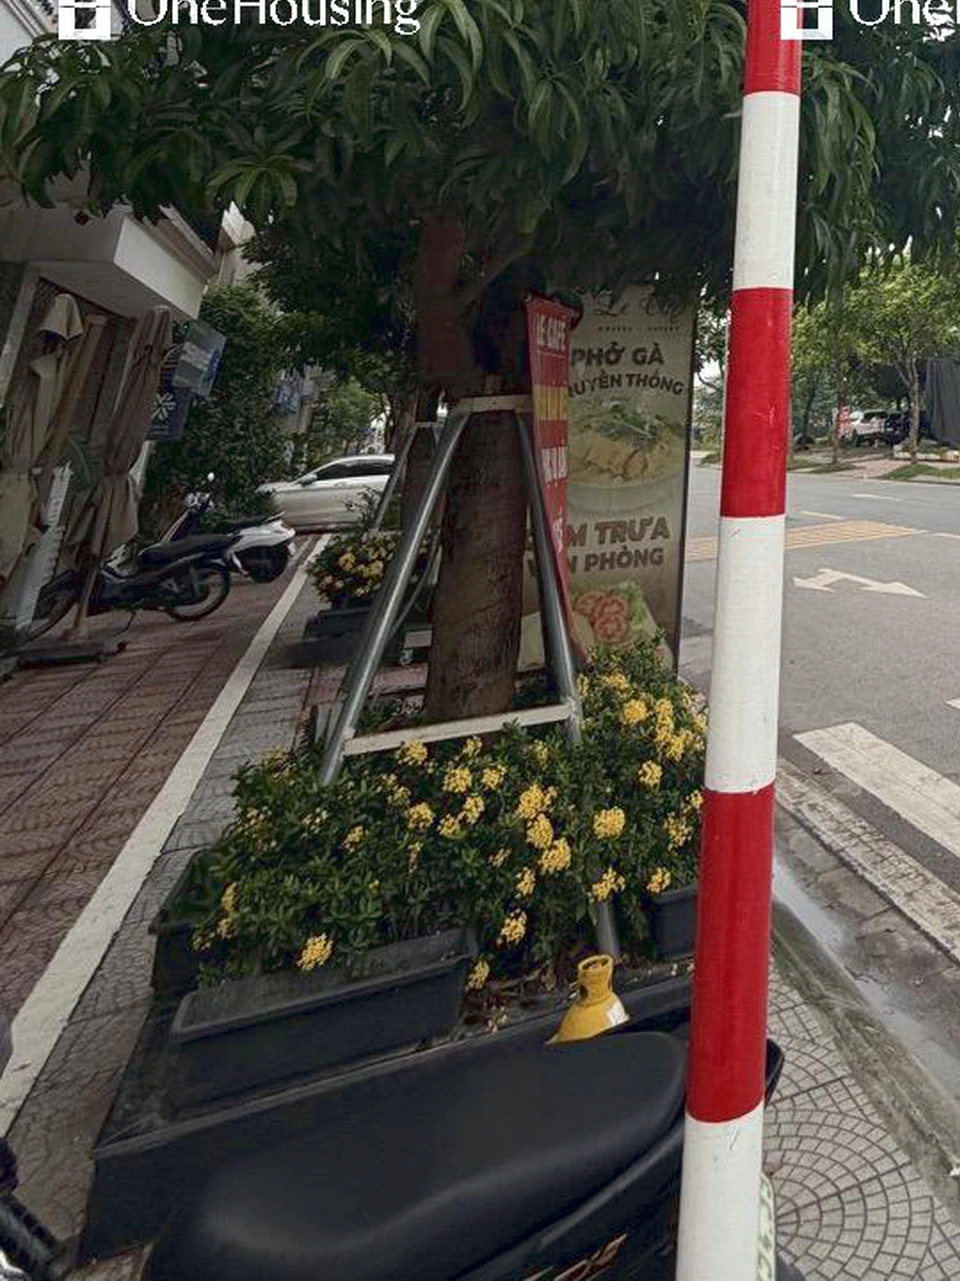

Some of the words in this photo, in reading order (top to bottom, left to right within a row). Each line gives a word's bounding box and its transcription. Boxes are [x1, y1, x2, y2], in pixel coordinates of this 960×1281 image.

[570, 341, 626, 367] PHỞ
[632, 342, 664, 366] GÀ
[594, 516, 671, 545] TRƯA
[584, 545, 664, 572] PHÒNG
